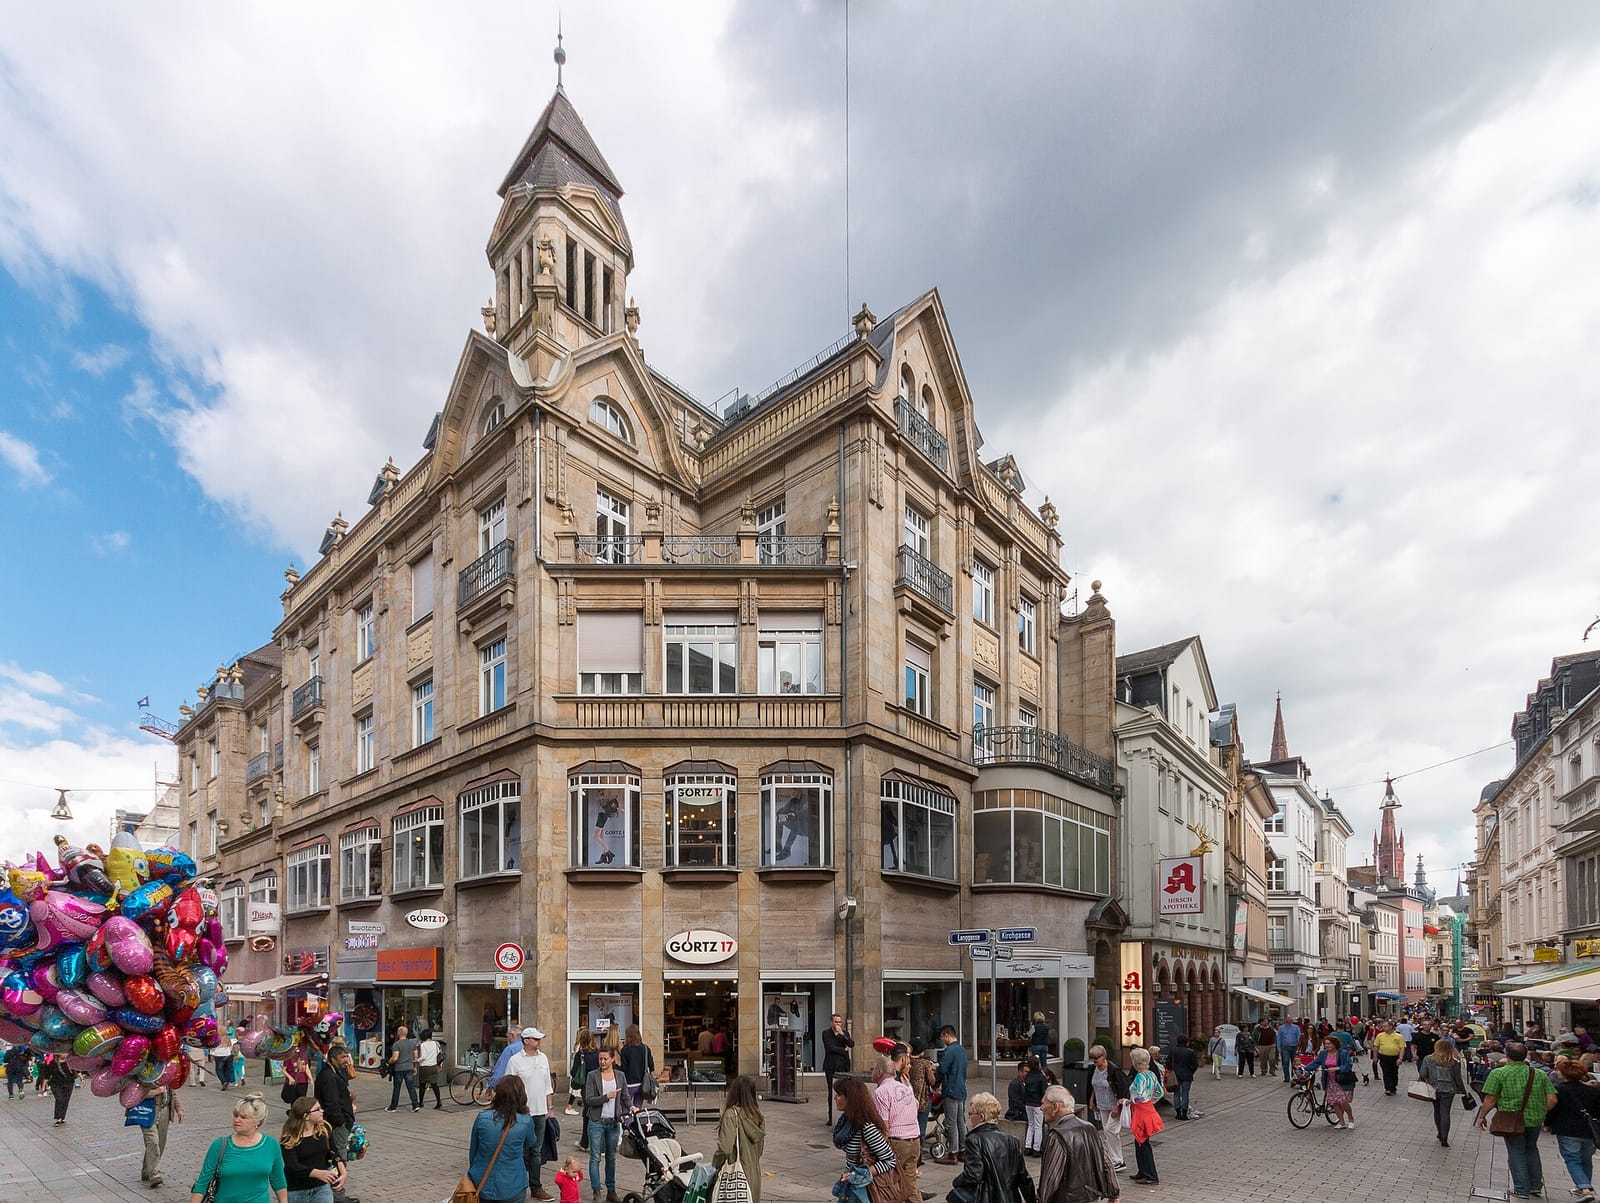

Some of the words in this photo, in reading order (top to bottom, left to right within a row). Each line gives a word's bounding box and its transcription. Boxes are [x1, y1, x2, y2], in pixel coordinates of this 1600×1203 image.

[1162, 903, 1199, 911] APOTHEKE
[957, 933, 981, 943] Langgasse
[1001, 931, 1031, 941] Kirchgasse
[720, 941, 734, 953] 17
